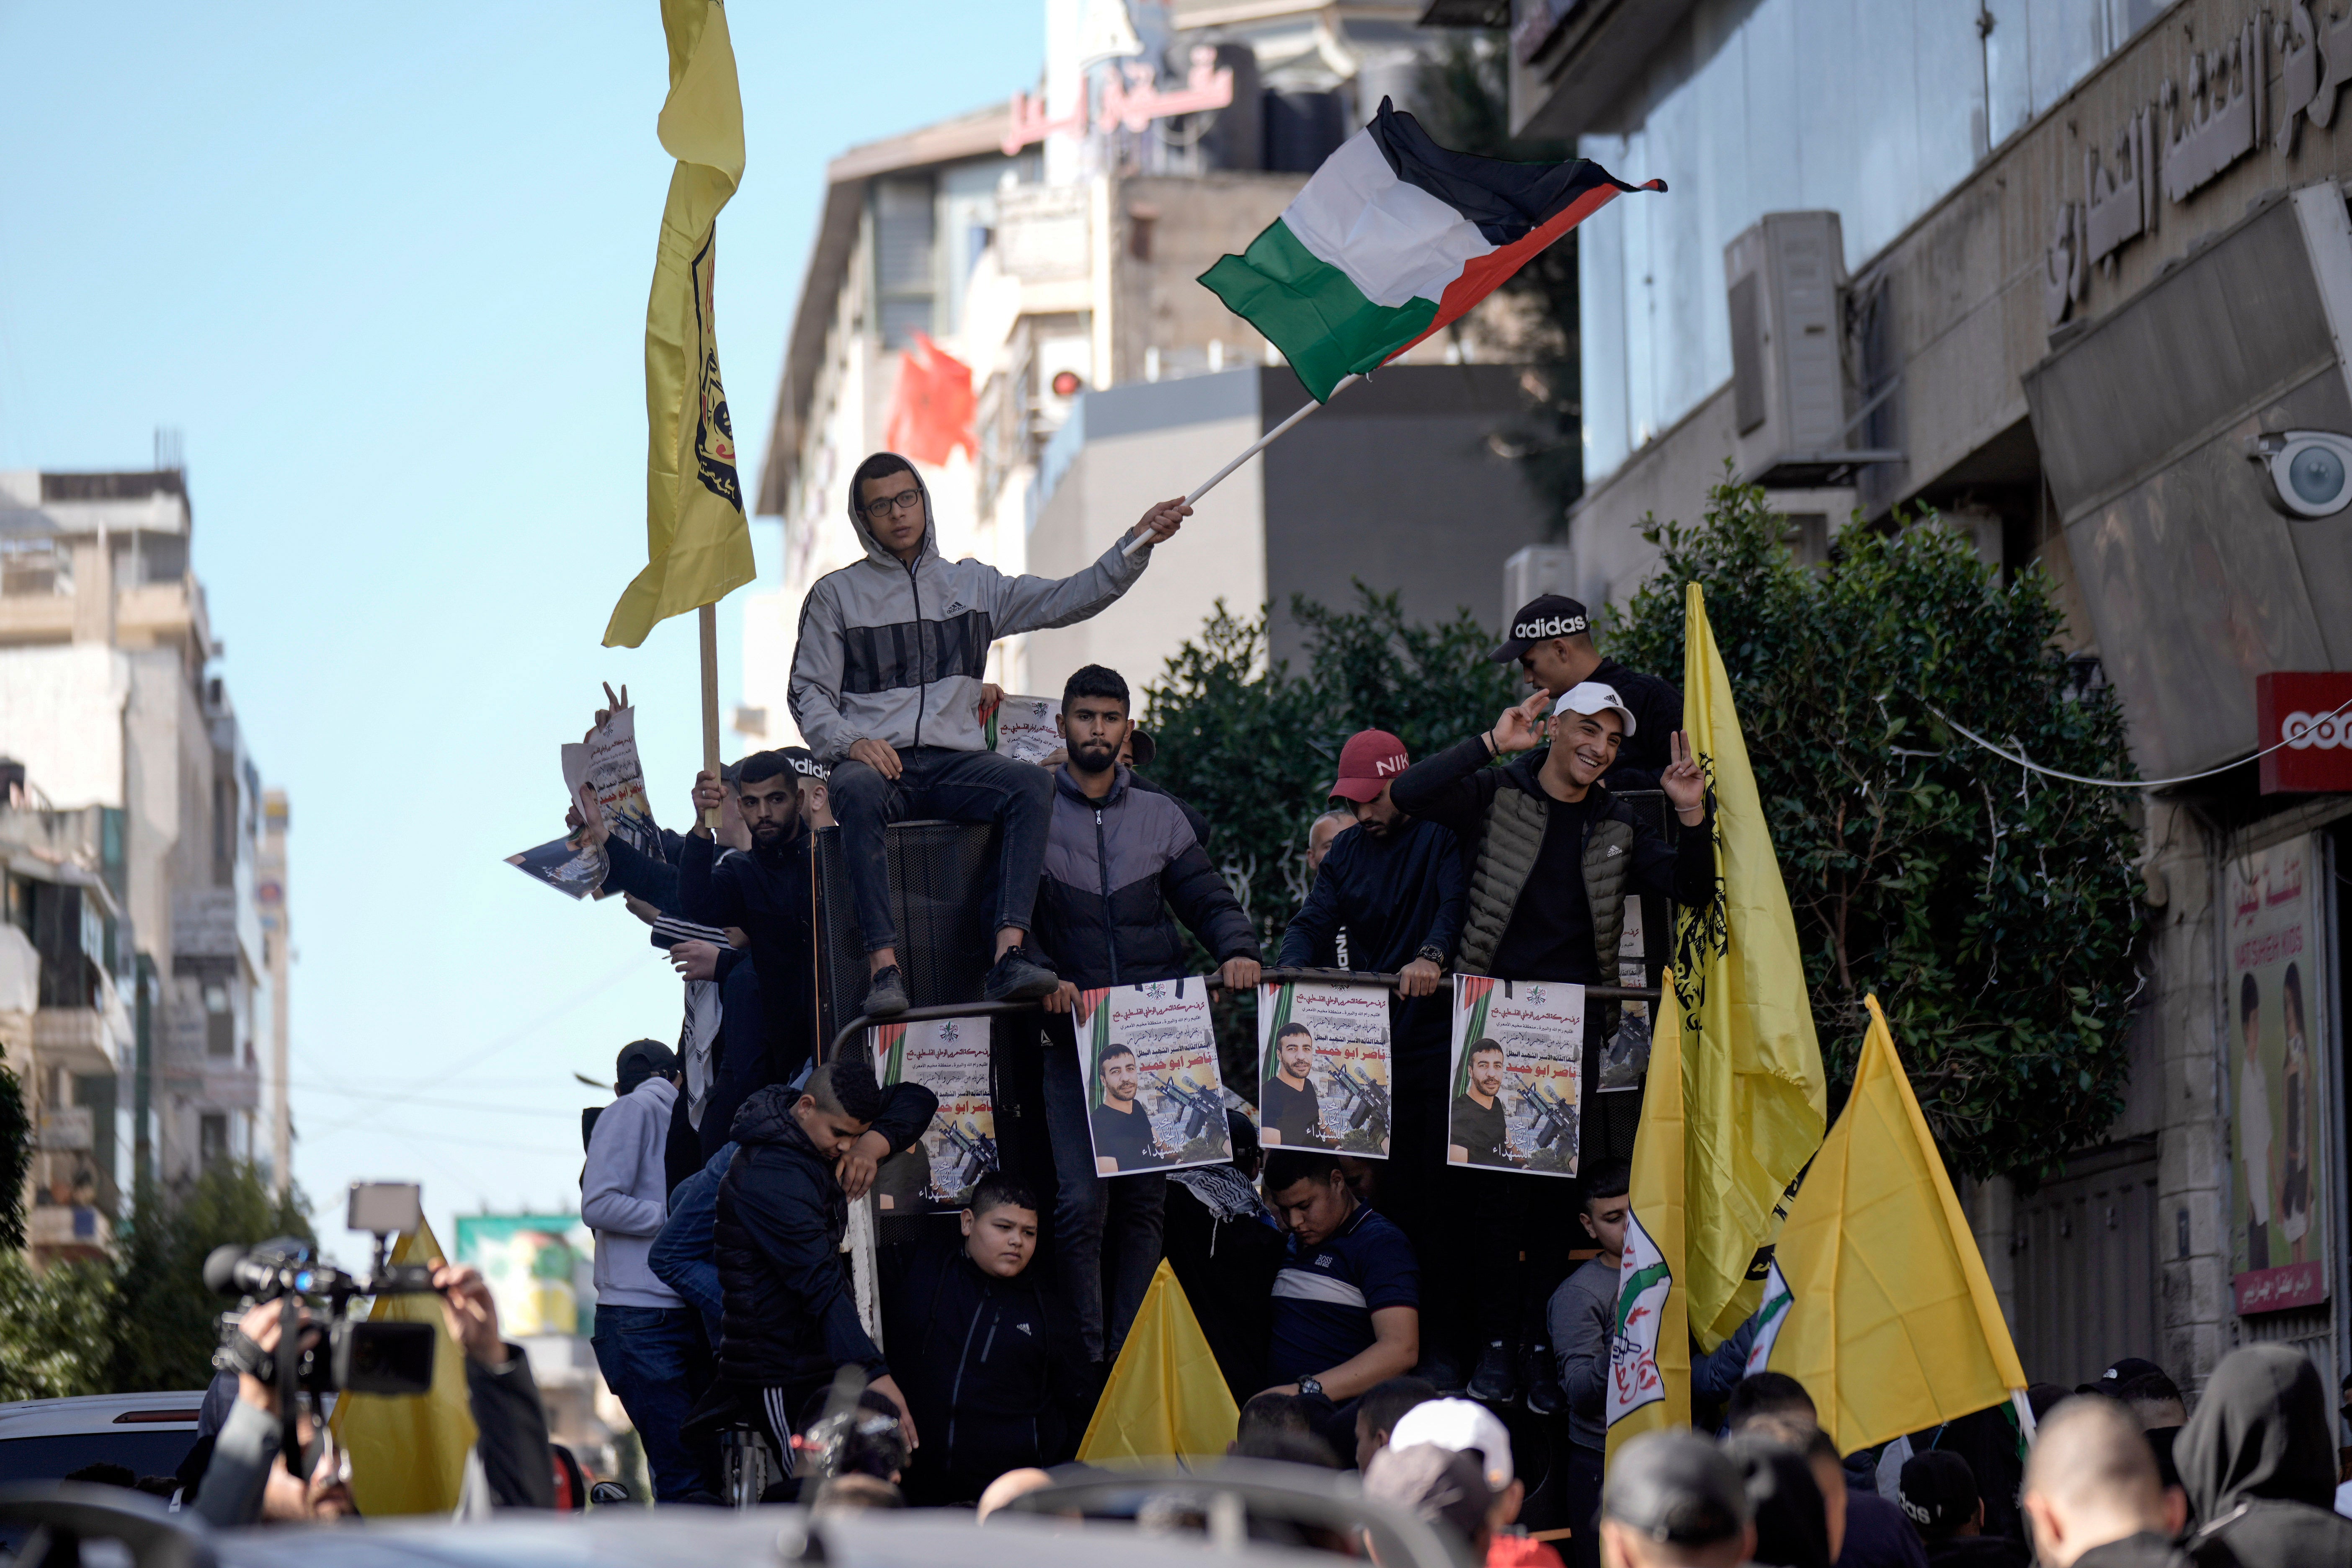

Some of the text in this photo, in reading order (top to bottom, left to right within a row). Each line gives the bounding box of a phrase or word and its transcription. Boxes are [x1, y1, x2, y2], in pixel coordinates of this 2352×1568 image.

[1515, 615, 1586, 638] adidas
[1376, 752, 1409, 776] NIK
[1176, 1030, 1183, 1039] من
[1354, 1023, 1361, 1031] من
[1547, 1038, 1555, 1047] من
[1315, 1046, 1385, 1062] ناصر ابو حميد
[1139, 1051, 1212, 1074] ناصر ابو حميد
[1505, 1063, 1576, 1080] ناصر ابو حميد
